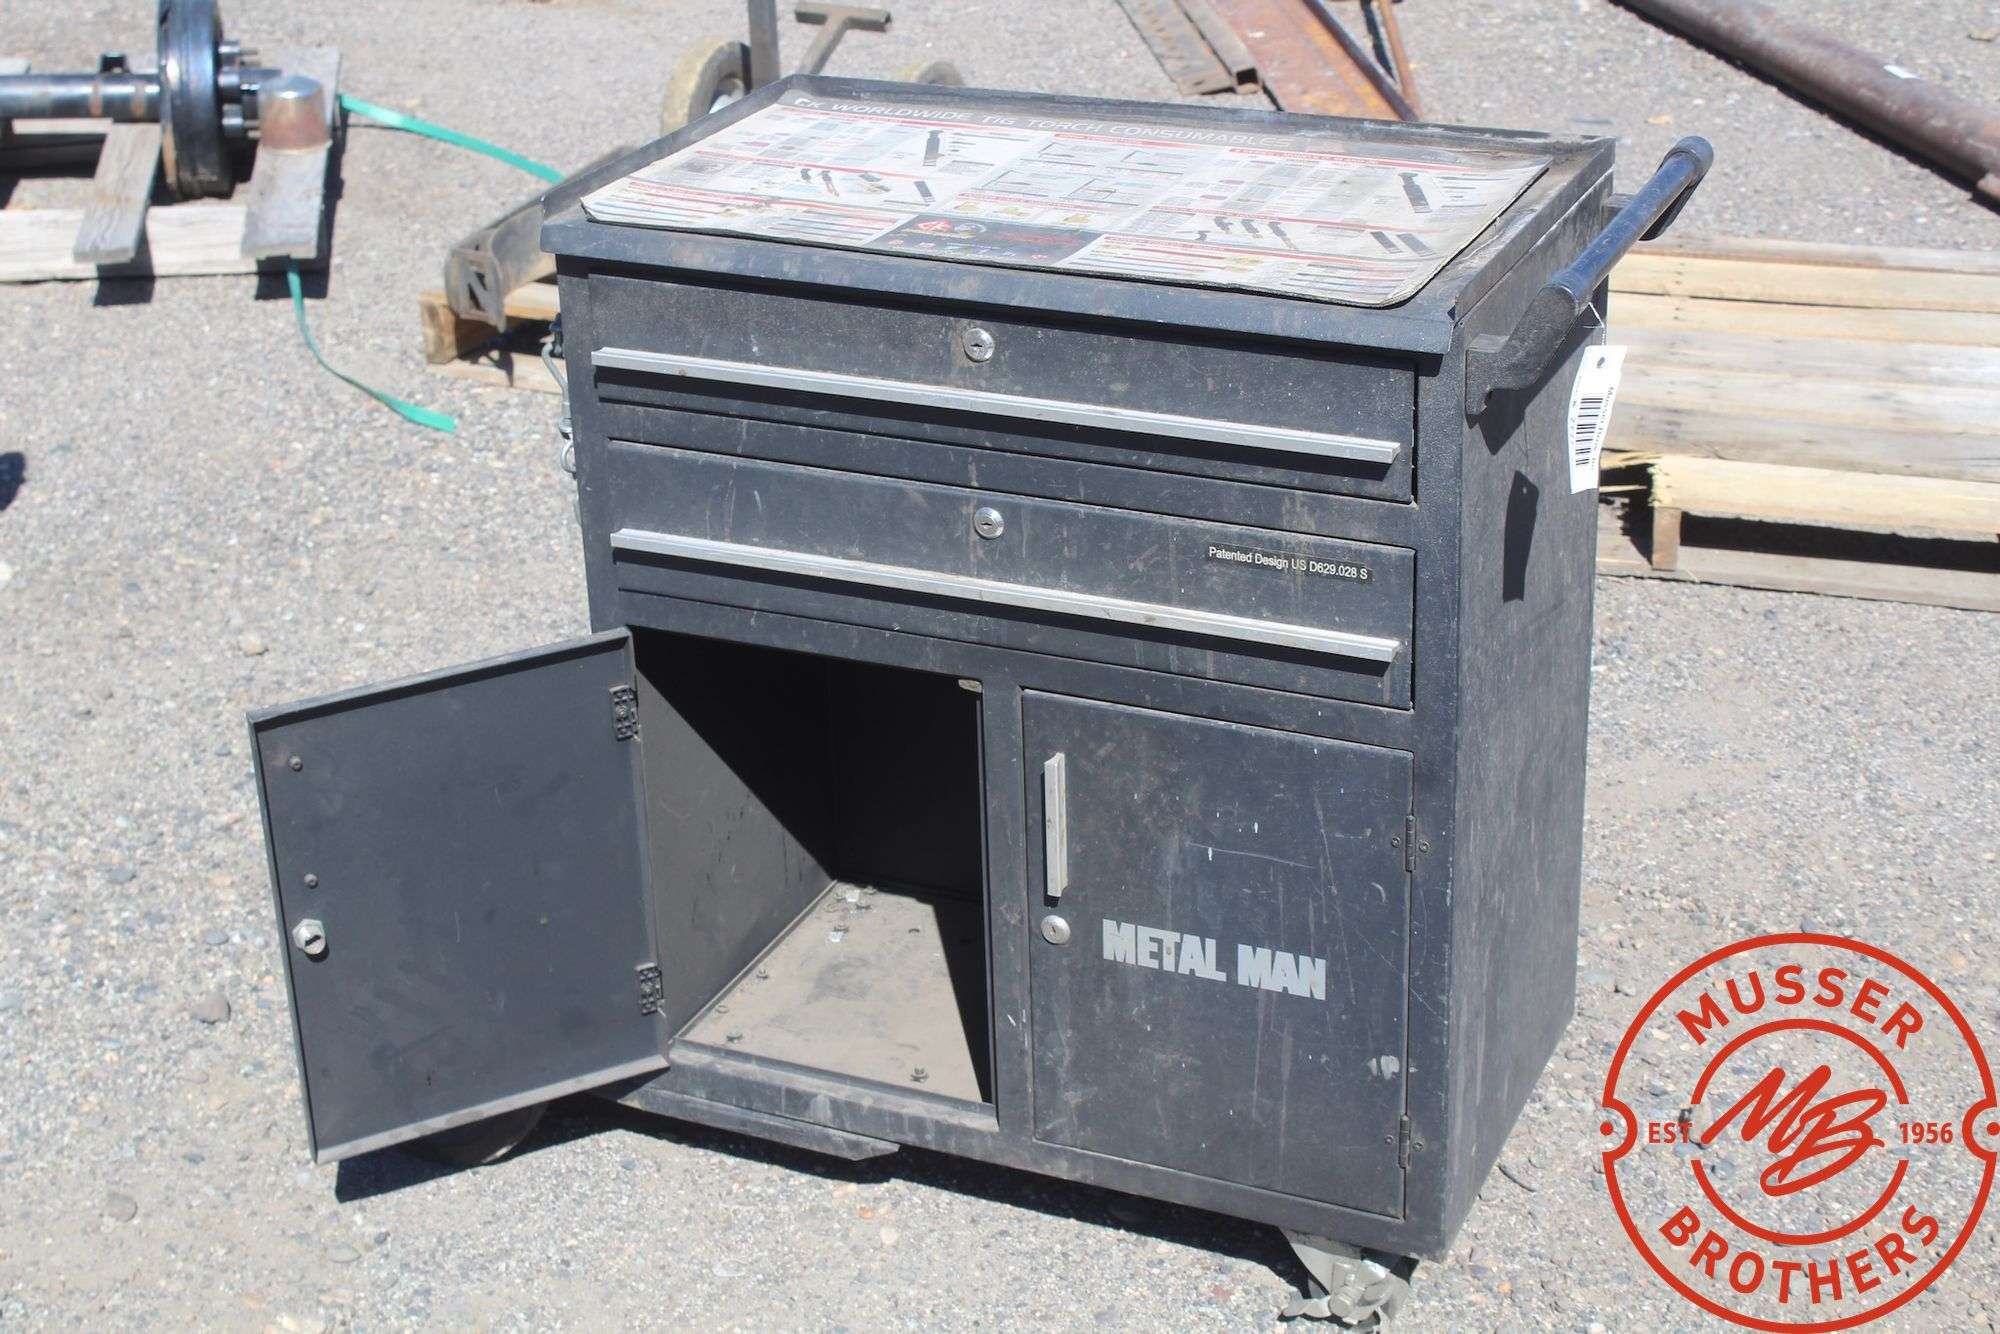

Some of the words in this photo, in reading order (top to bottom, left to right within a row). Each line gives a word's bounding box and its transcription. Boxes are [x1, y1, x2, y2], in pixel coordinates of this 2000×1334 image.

[831, 102, 974, 120] WORLDWIDE
[982, 114, 1016, 126] TIG
[1027, 119, 1103, 133] TORCH
[1109, 124, 1295, 147] CONSUMABLES
[1208, 546, 1252, 563] Patented
[1255, 554, 1288, 570] Design
[1292, 558, 1307, 571] US
[1309, 561, 1357, 578] D629.028
[1360, 568, 1368, 580] S
[1102, 918, 1227, 982] METAL
[1238, 943, 1327, 1000] MAN
